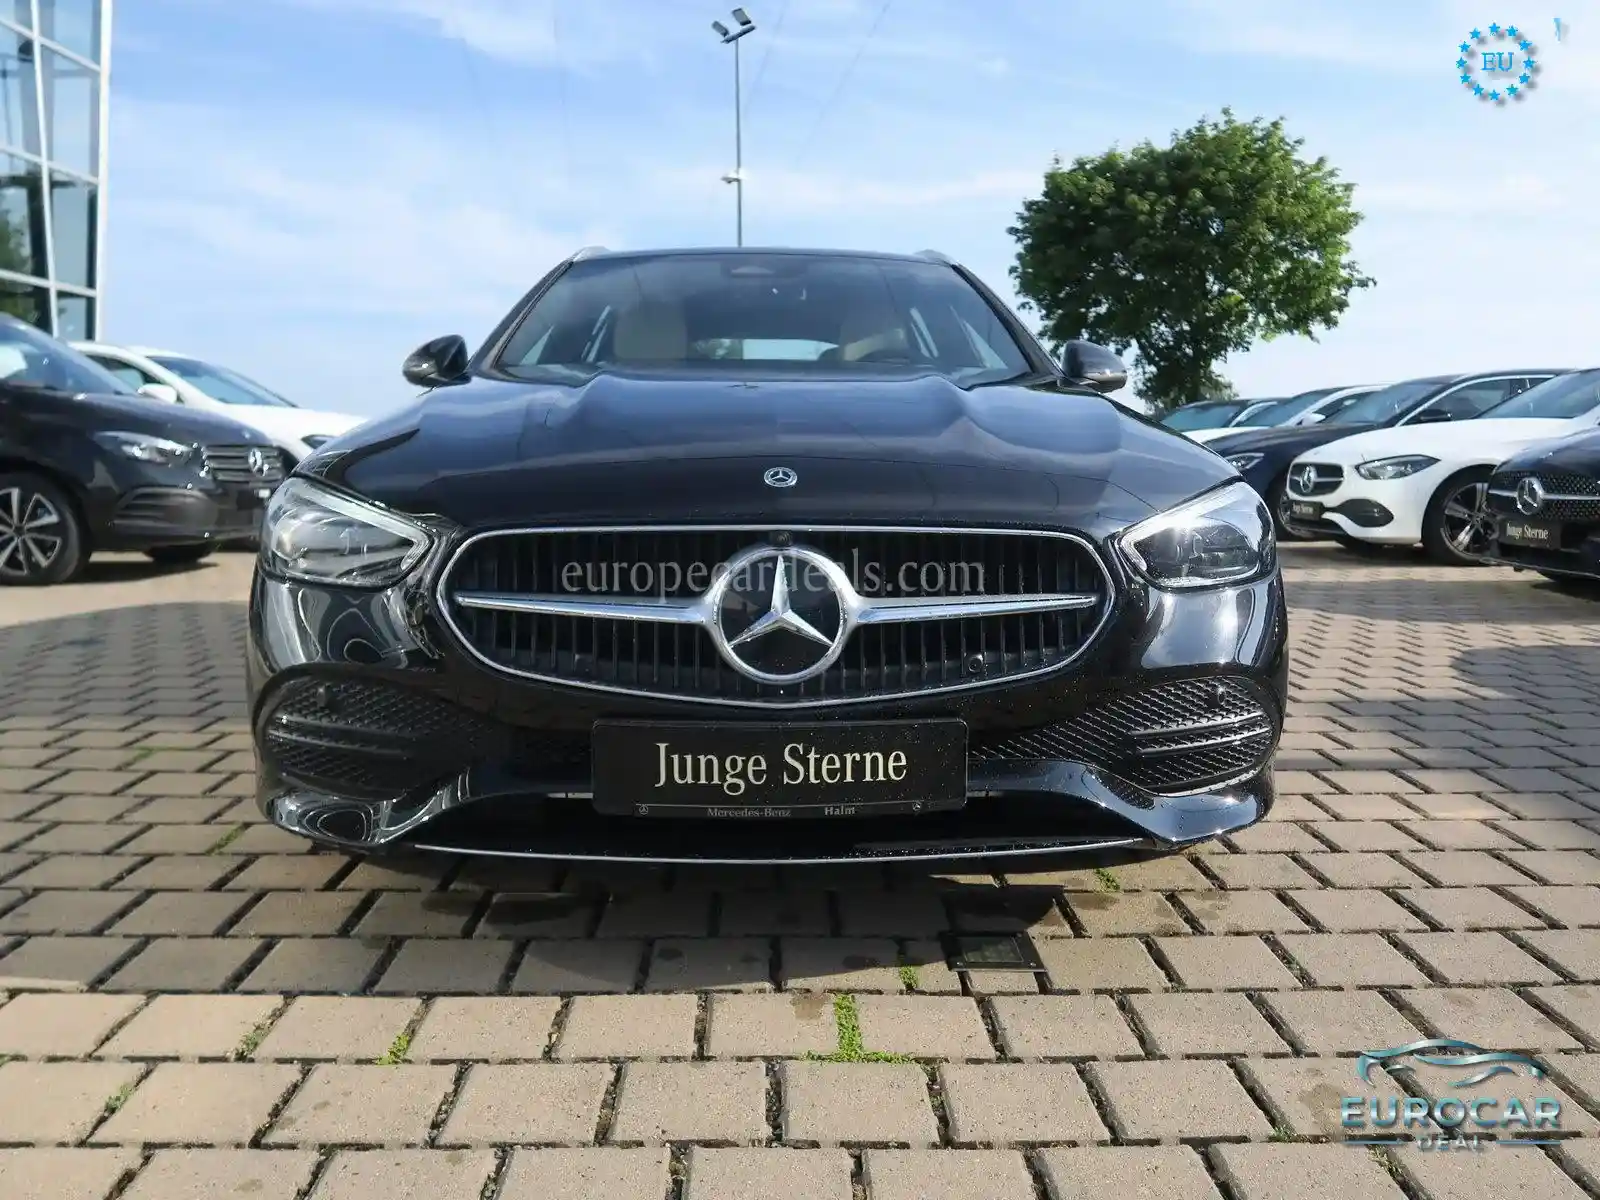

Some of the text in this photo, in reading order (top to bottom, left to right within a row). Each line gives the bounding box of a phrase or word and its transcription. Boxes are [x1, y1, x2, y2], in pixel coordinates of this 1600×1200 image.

[654, 742, 908, 796] Junge Sterne
[706, 807, 792, 818] Mercedes-Benz
